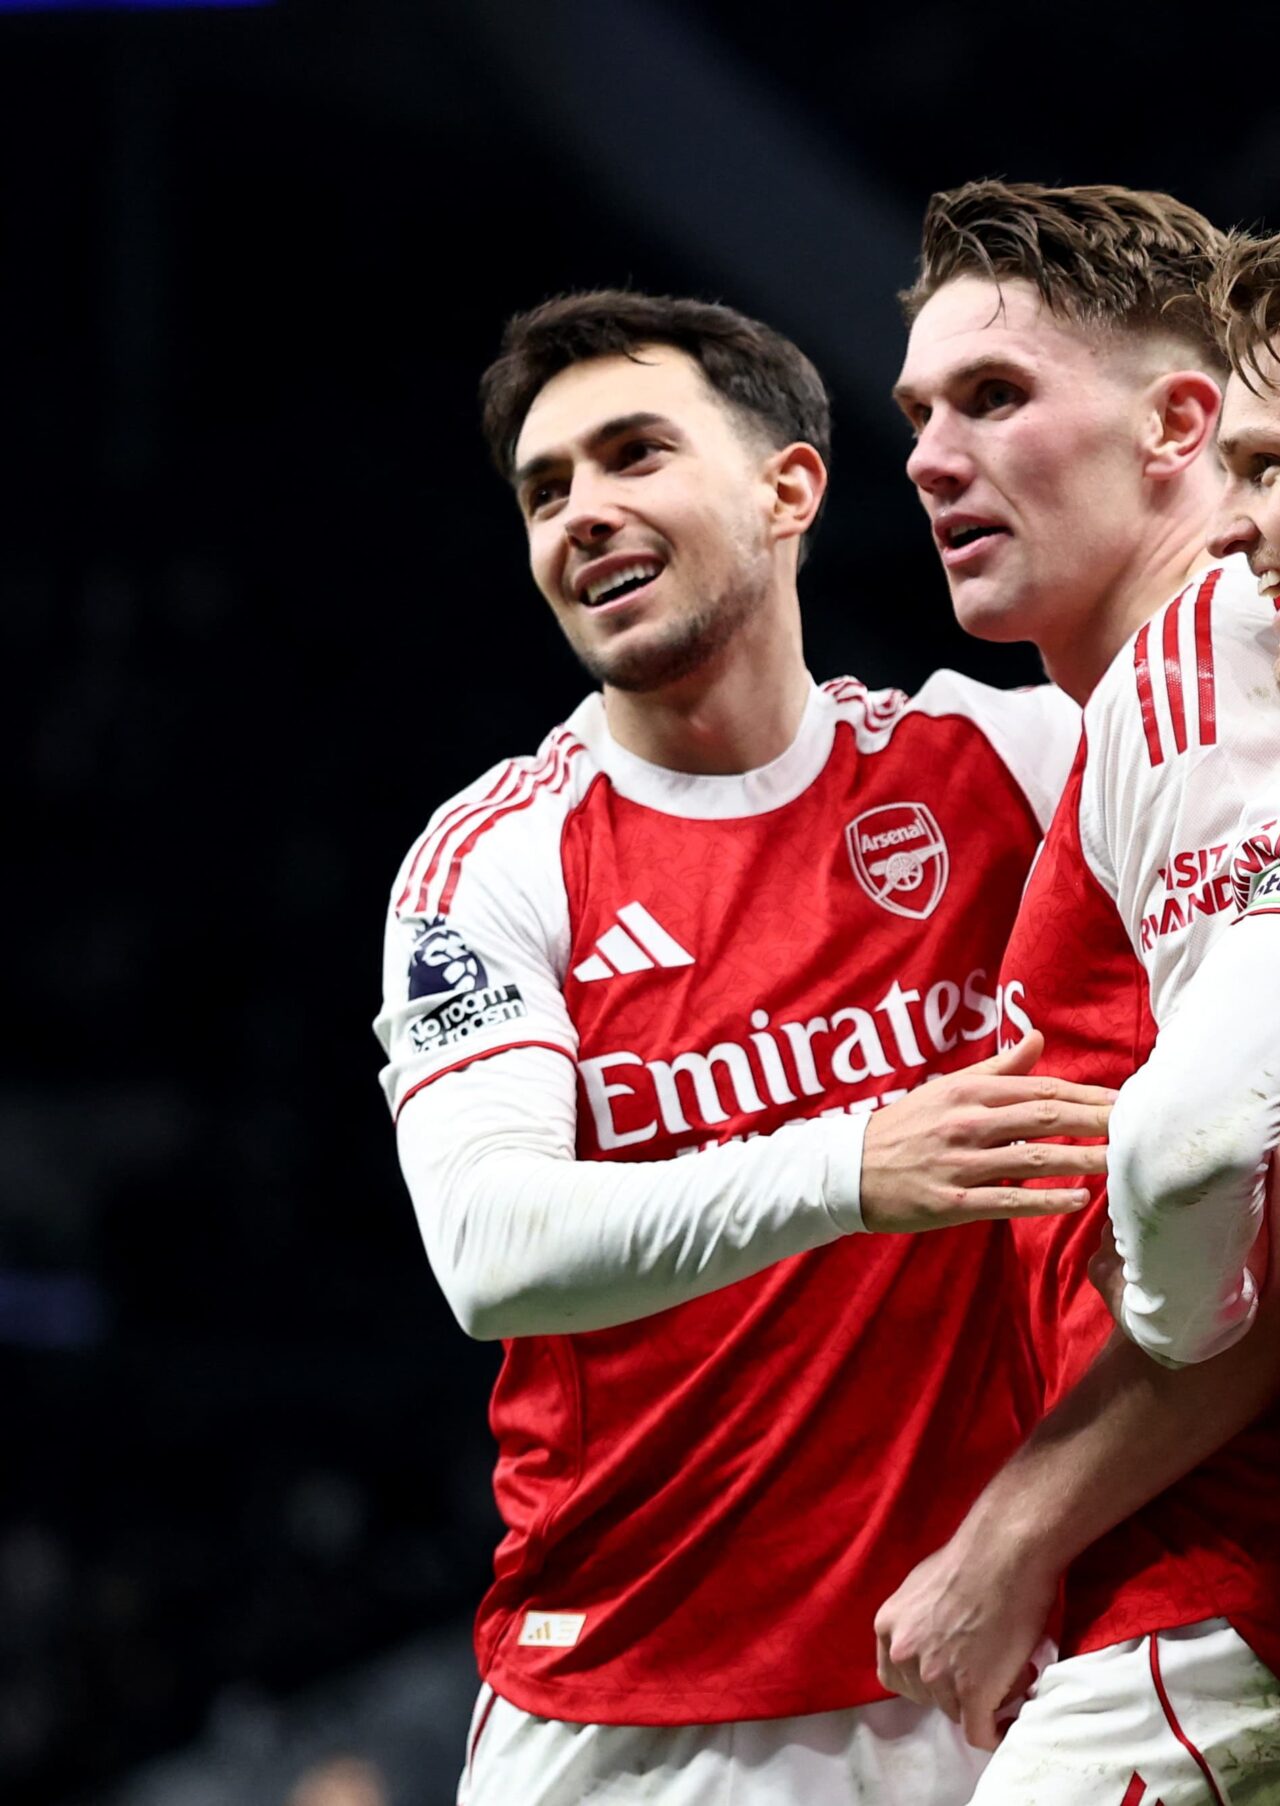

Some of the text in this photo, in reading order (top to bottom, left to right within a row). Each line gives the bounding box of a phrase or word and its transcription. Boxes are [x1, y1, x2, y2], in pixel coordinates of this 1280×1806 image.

[861, 818, 926, 854] Arsenal
[410, 987, 509, 1046] No room
[445, 999, 528, 1043] racism
[577, 969, 999, 1151] Emirates
